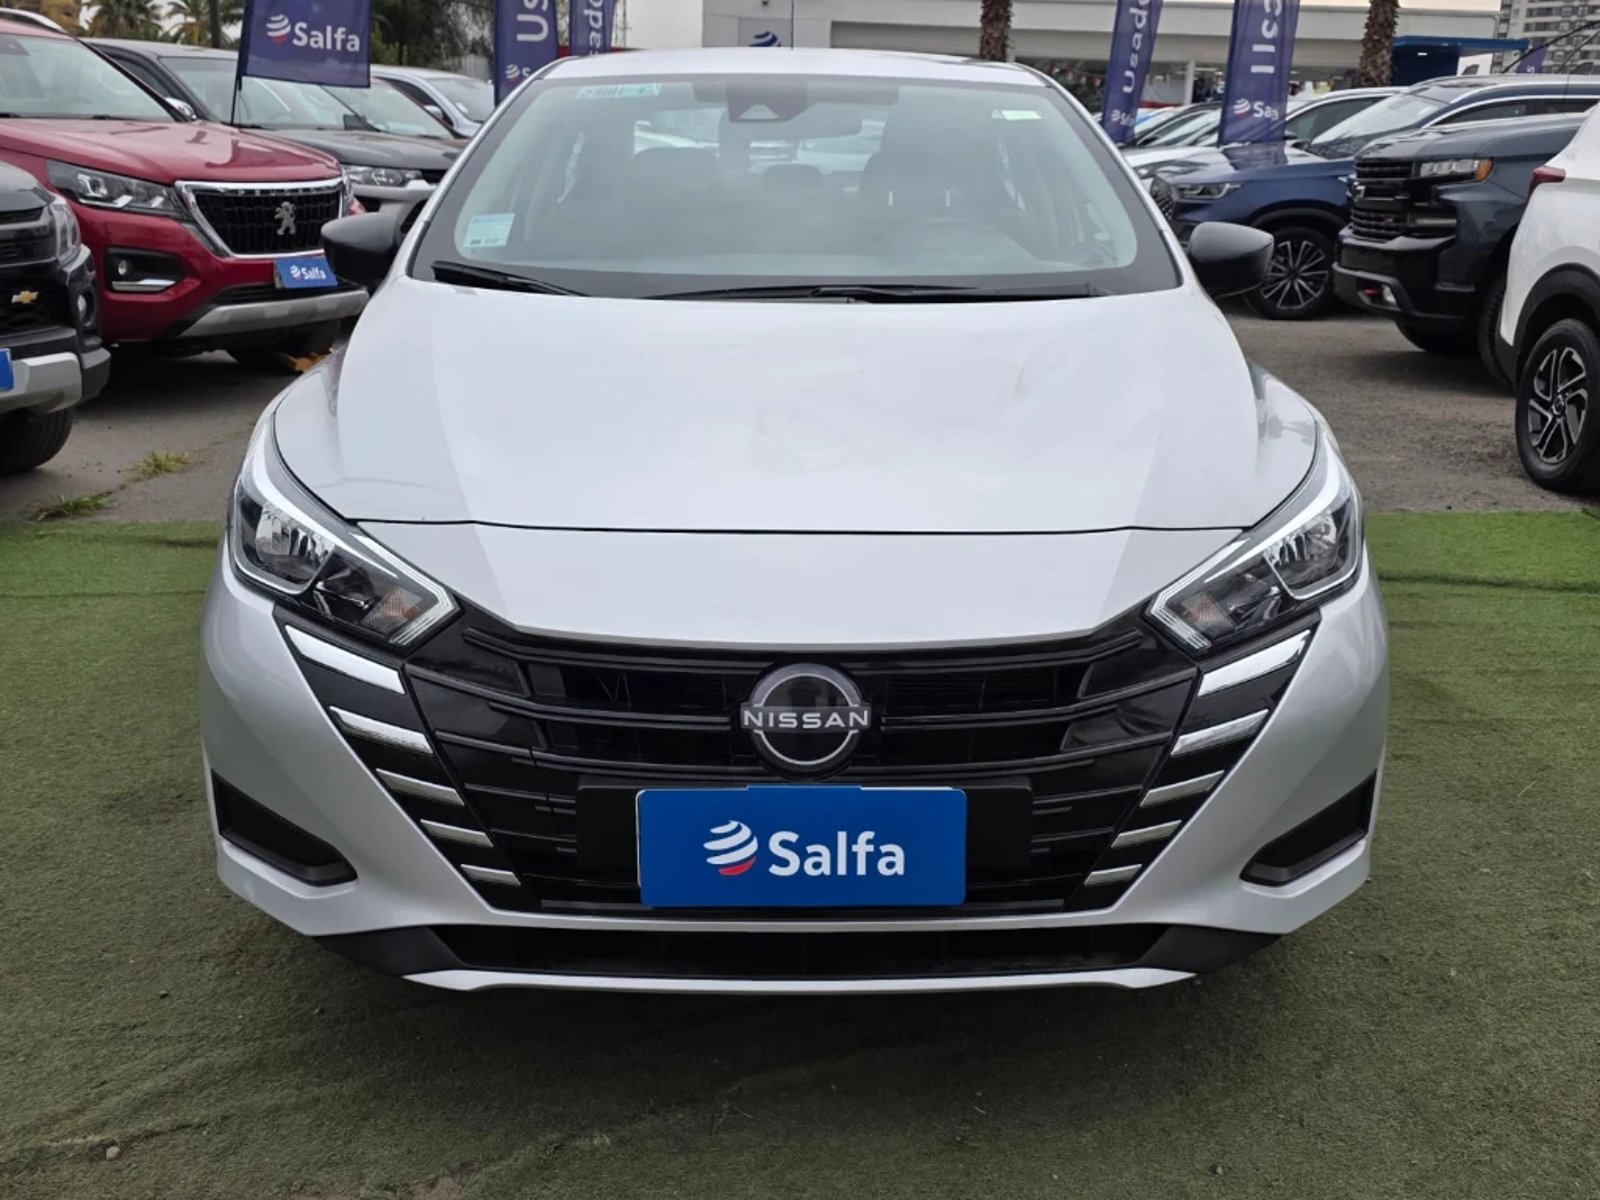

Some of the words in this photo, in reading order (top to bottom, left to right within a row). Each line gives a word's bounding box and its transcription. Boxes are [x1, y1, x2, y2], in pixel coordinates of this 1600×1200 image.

[292, 21, 360, 52] Salfa
[743, 709, 868, 729] NISSAN
[768, 831, 905, 876] Salfa
